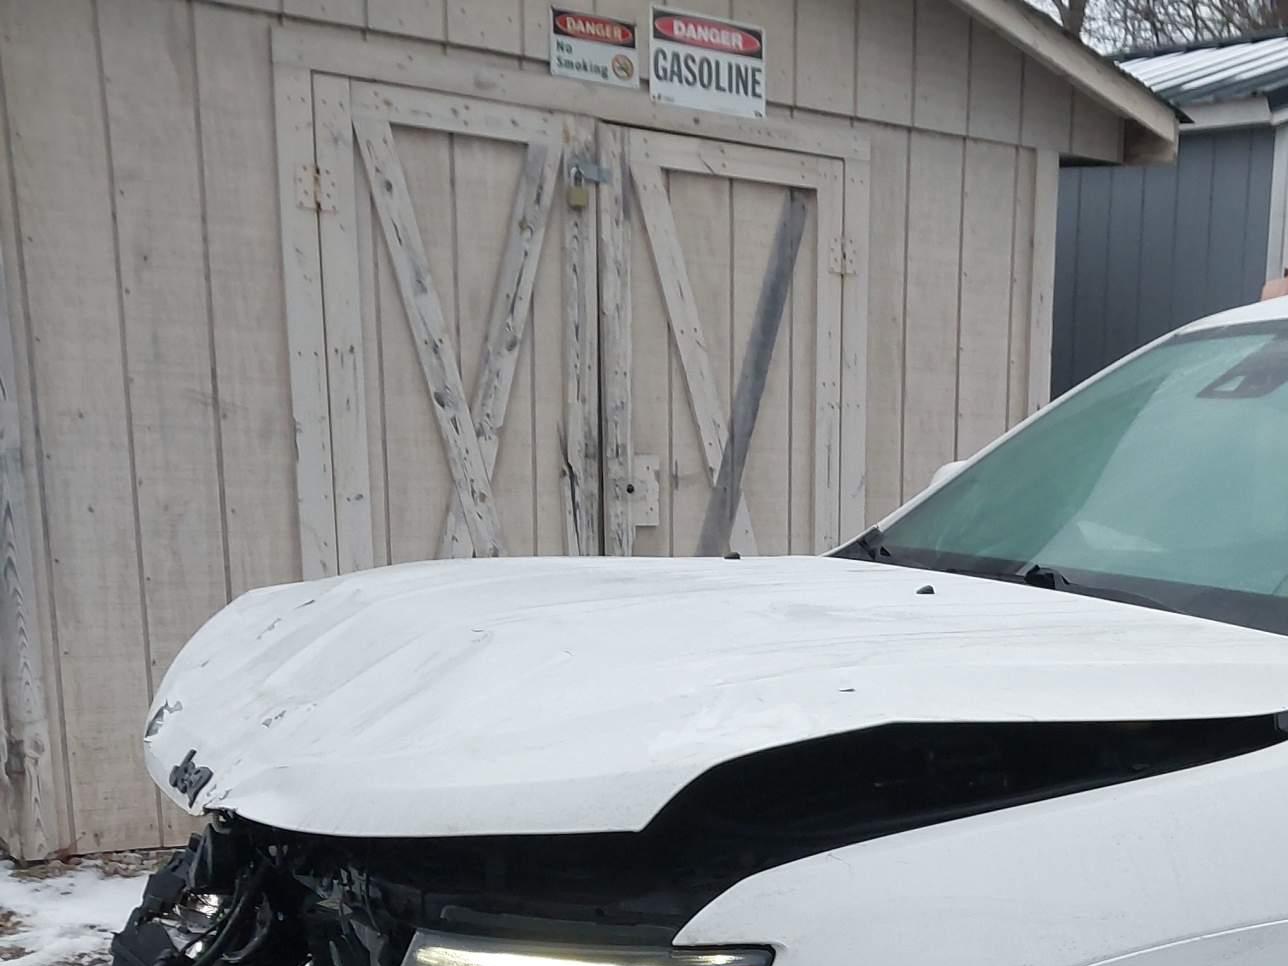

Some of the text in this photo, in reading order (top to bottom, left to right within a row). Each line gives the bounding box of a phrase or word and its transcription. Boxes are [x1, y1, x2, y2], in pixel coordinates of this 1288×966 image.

[566, 16, 622, 41] DANGER
[673, 16, 743, 50] DANGER
[556, 40, 573, 54] No
[556, 56, 609, 80] Smoking
[653, 47, 763, 99] GASOLINE
